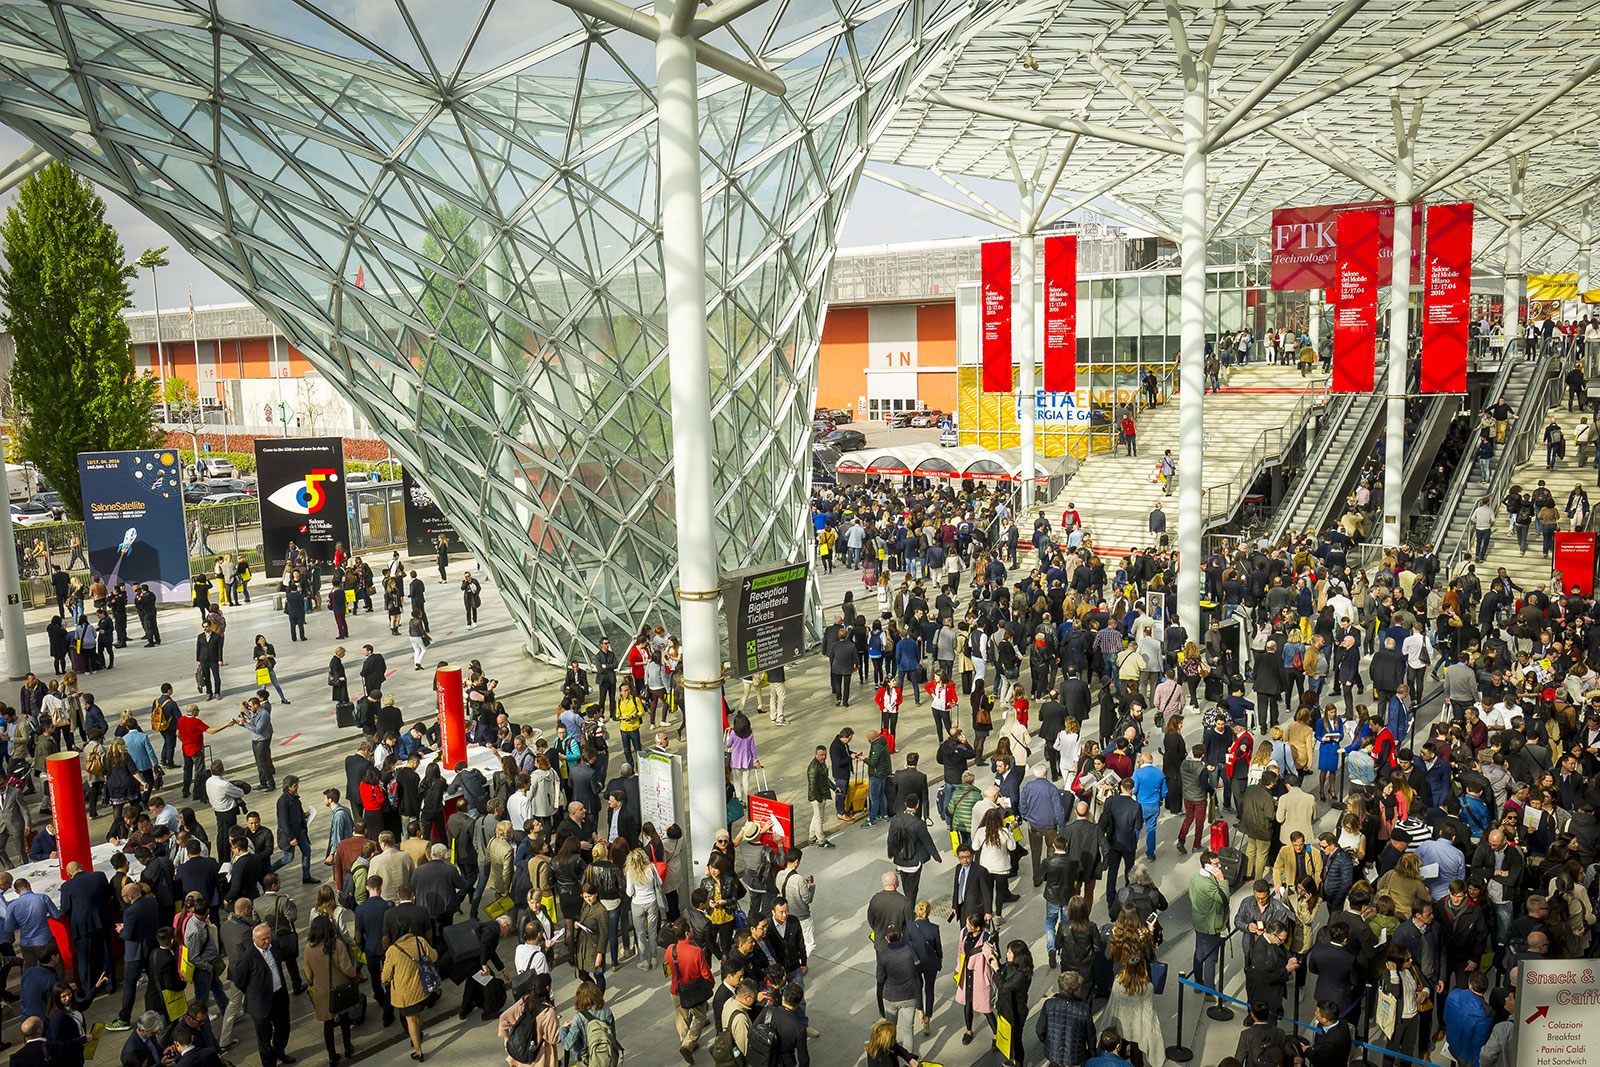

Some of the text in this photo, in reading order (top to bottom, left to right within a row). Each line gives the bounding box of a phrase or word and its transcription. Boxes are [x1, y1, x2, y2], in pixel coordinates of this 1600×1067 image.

[1275, 221, 1337, 250] FTK
[1378, 248, 1416, 258] Kitn
[1274, 253, 1331, 265] Technology
[1018, 410, 1063, 420] ERGIA
[91, 501, 145, 512] SaloneSatellite
[750, 586, 787, 602] Reception
[748, 596, 789, 614] Biglietterie
[747, 611, 775, 624] Tickets
[1526, 968, 1595, 985] Snack &
[1548, 1021, 1583, 1029] Colazioni
[1566, 1045, 1586, 1053] Caldi
[1552, 1057, 1587, 1065] Sandwich
